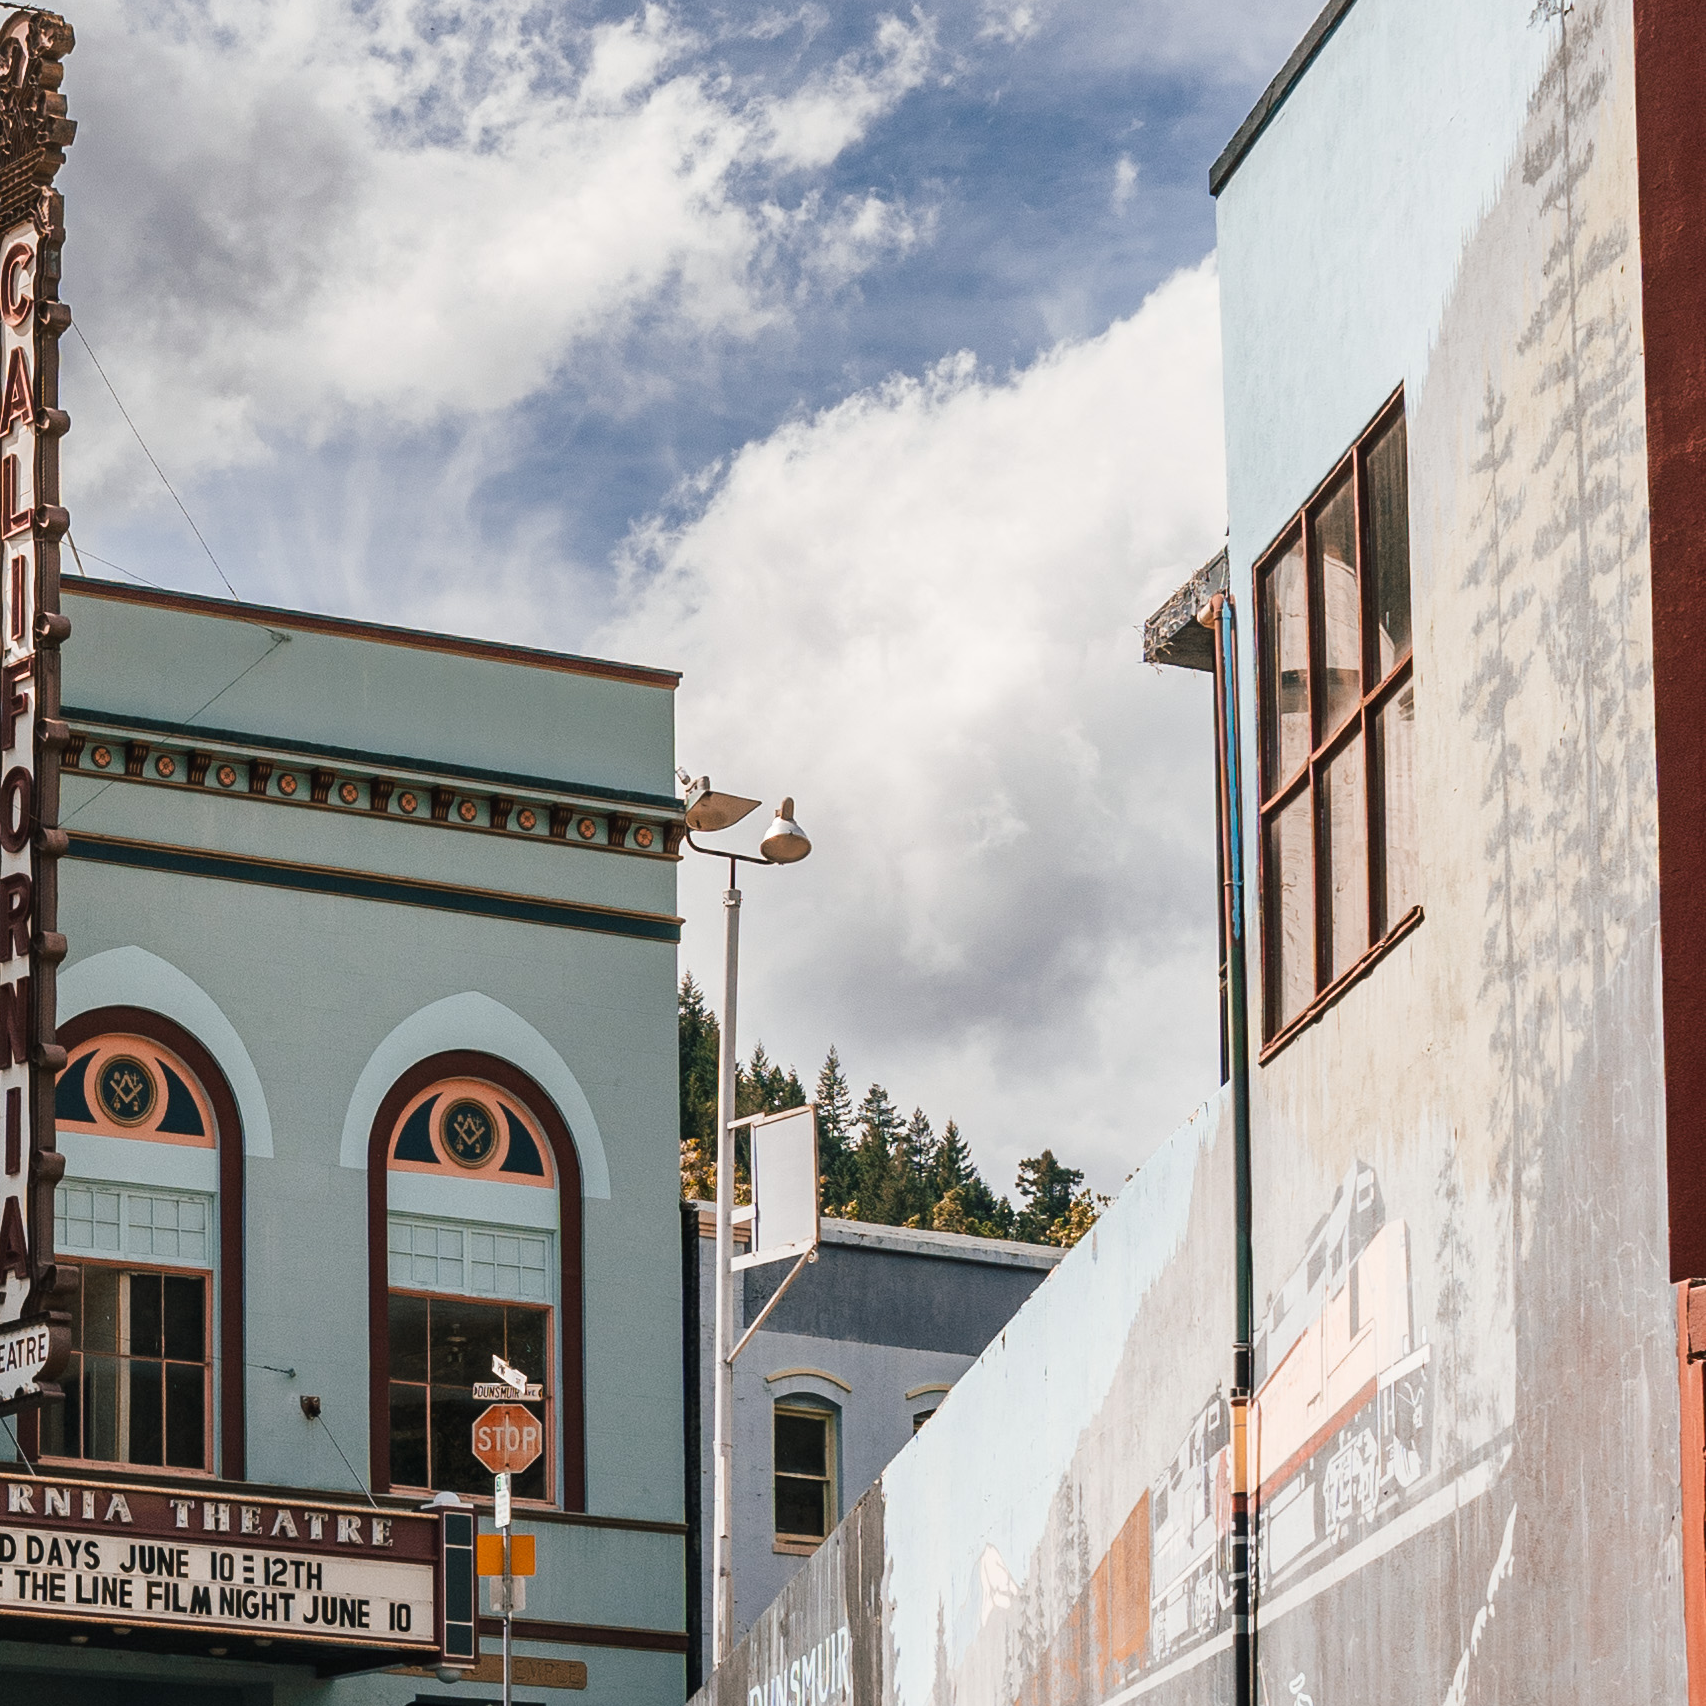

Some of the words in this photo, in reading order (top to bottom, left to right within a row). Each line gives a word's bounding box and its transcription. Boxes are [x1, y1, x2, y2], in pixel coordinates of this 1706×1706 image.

[477, 1385, 520, 1399] DUNSMUIR
[477, 1426, 537, 1452] STOP
[169, 1498, 394, 1547] THEATRE
[26, 1534, 101, 1571] DAYS
[119, 1544, 190, 1579] JUNE
[210, 1551, 235, 1582] 10
[263, 1556, 323, 1591] 12TH
[14, 1569, 66, 1603] THE
[75, 1574, 133, 1609] LINE
[146, 1580, 212, 1616] FILM
[219, 1587, 296, 1622] NIGHT
[303, 1595, 370, 1629] JUNE
[388, 1601, 412, 1633] 10
[500, 1657, 582, 1686] EMPLE
